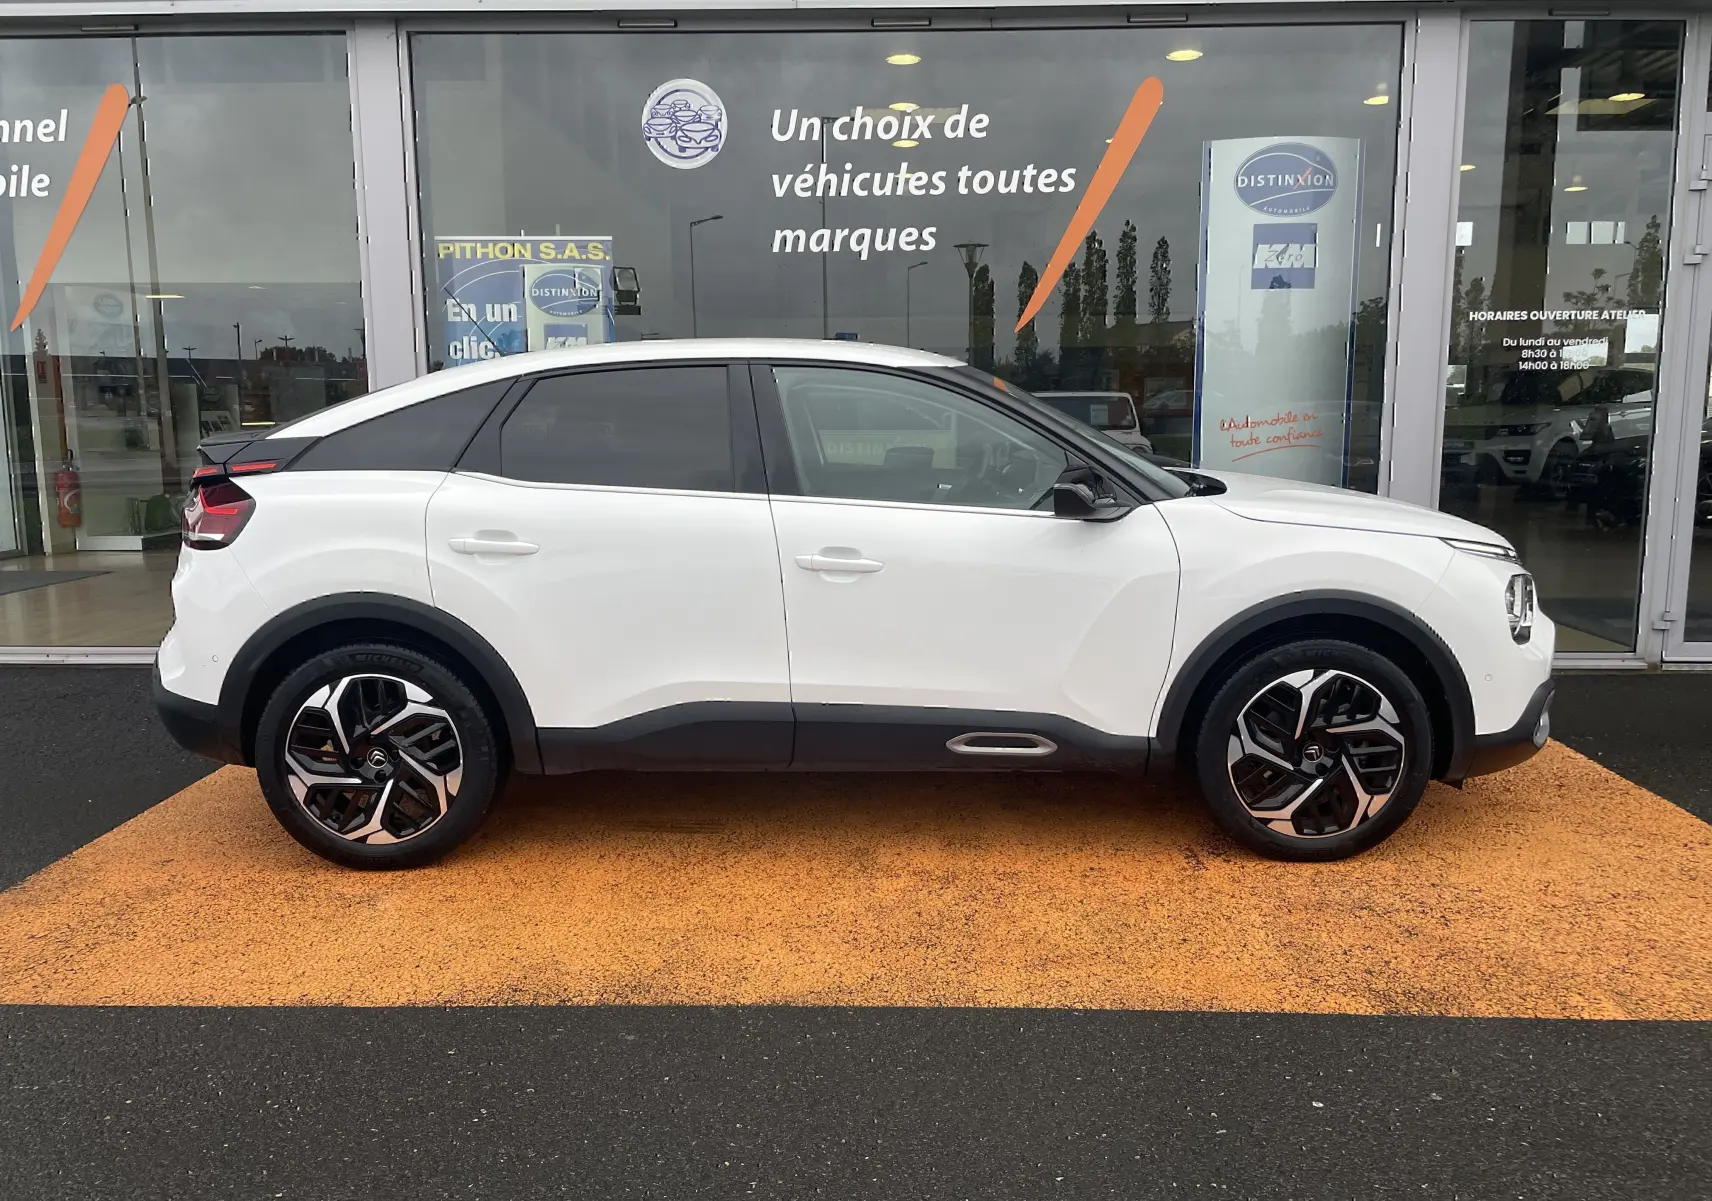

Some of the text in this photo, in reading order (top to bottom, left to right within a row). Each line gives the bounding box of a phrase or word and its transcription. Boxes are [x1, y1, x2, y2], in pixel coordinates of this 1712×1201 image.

[771, 103, 990, 142] Un choix de
[772, 162, 1077, 198] véhicules toutes
[1237, 170, 1334, 189] DISTINXION
[438, 242, 611, 261] PITHON S.A.S.
[772, 225, 937, 261] marques
[531, 287, 598, 298] DISTINXION
[446, 298, 518, 322] En un
[1469, 309, 1646, 321] HORAIRES OUVERTURE ATELIER
[1503, 336, 1608, 347] Du lundi au vendredi
[1521, 349, 1547, 358] 8h30
[1550, 349, 1557, 358] à
[1518, 360, 1590, 370] 14h00 à 18h00
[1303, 412, 1318, 421] en
[1230, 427, 1323, 448] toute confiance
